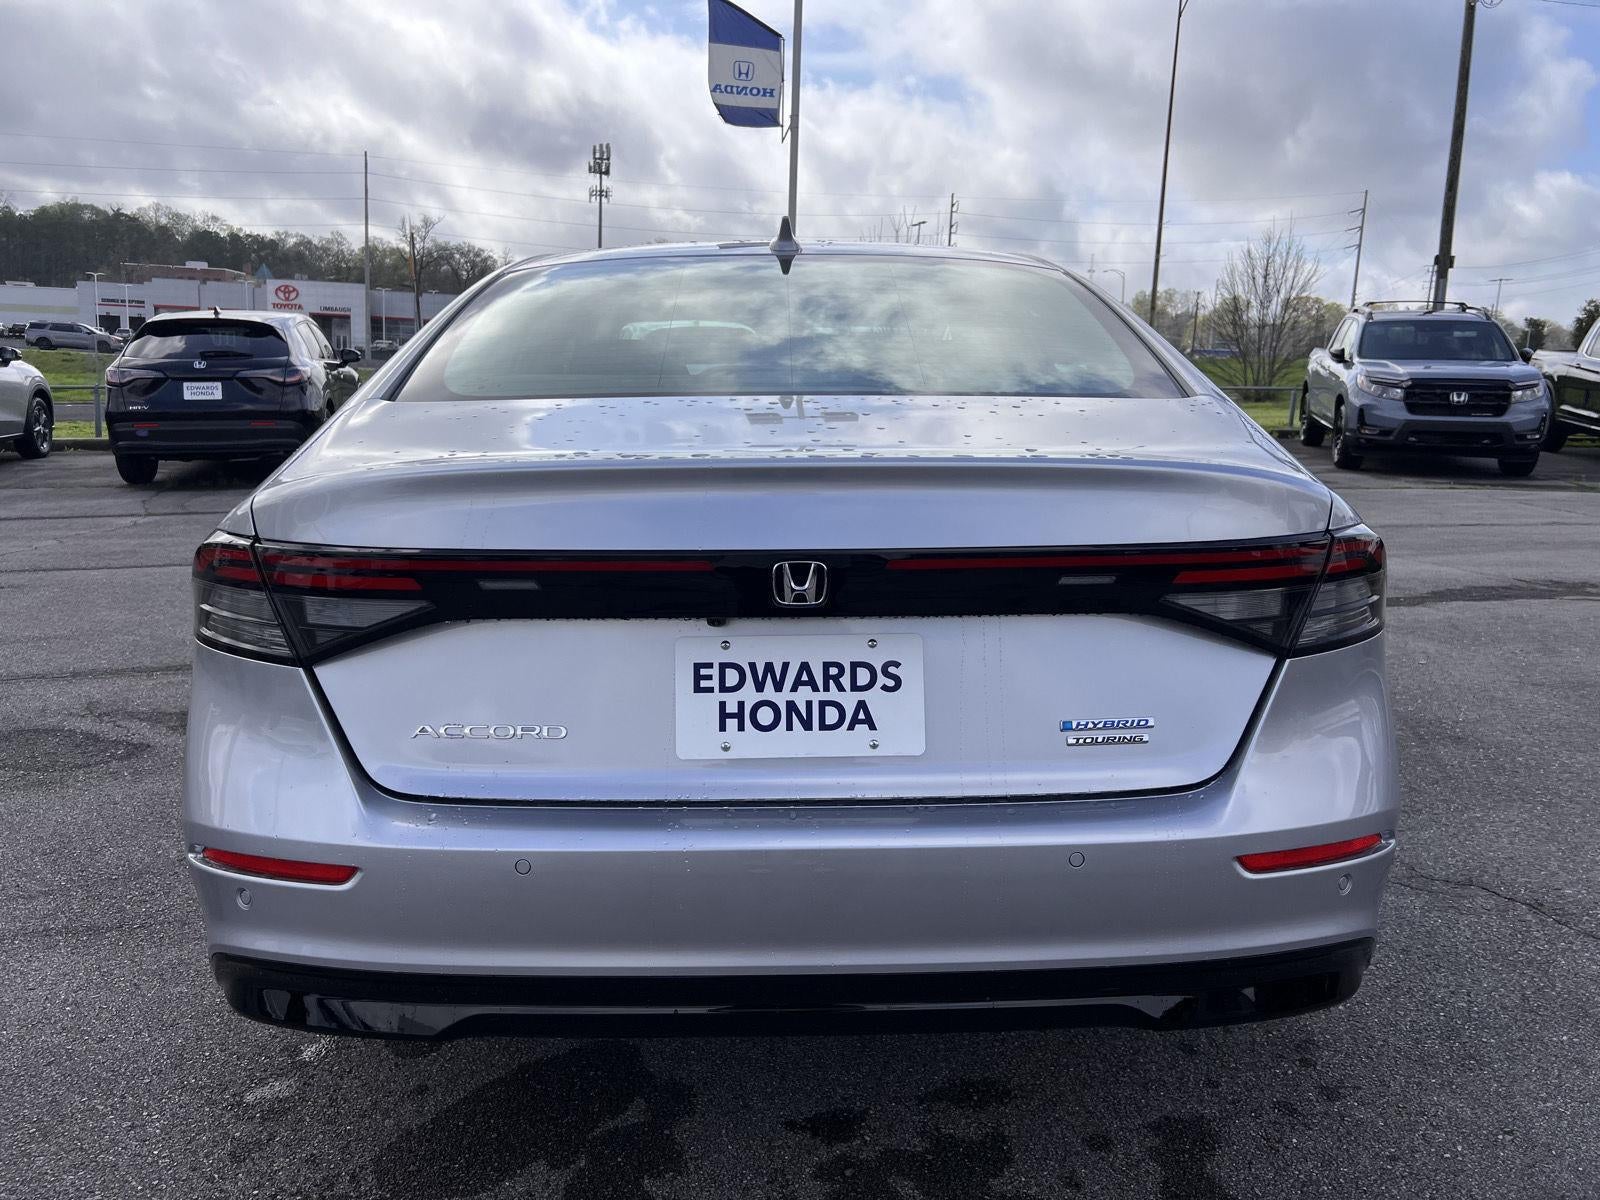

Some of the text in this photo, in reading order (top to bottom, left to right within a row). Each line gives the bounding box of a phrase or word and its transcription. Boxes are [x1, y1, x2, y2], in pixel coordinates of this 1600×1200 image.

[692, 659, 903, 694] EDWARDS
[718, 699, 878, 733] HONDA
[1075, 719, 1149, 729] HYBRID
[411, 723, 568, 740] ACCORD
[1072, 735, 1144, 744] TOURING
